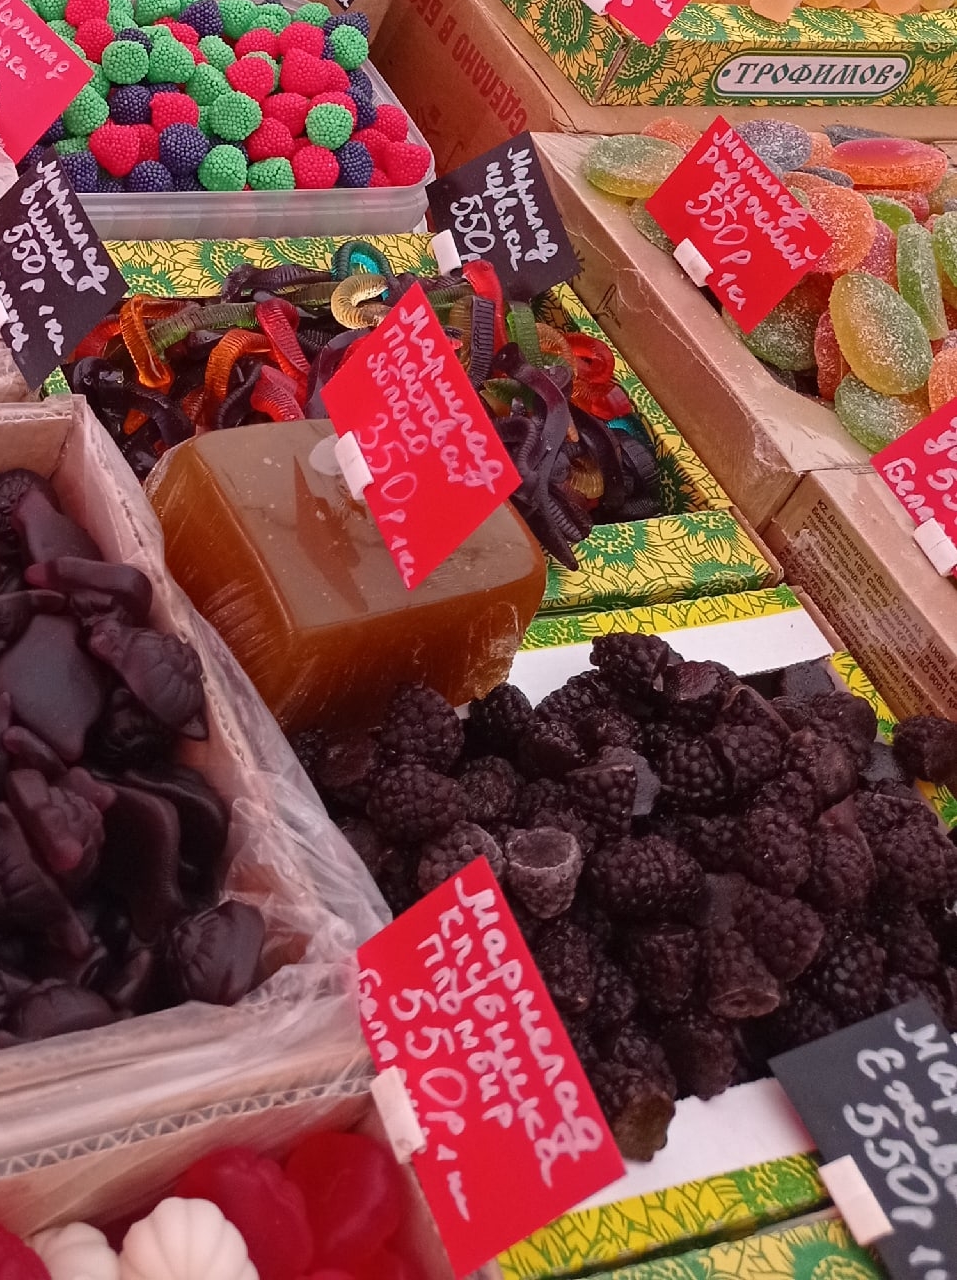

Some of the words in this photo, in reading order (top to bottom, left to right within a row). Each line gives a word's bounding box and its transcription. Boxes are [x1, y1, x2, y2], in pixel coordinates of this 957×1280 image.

[438, 15, 457, 45] В
[452, 33, 527, 137] СДЕЛАНО
[738, 62, 895, 86] ТРОФИМОВ
[37, 156, 109, 295] Мармелад
[483, 162, 520, 272] червяки
[508, 147, 559, 264] Мармелад
[685, 192, 751, 265] 550р
[712, 127, 808, 231] Мармелад
[3, 220, 45, 293] 550р
[399, 303, 503, 494] Мармелад
[355, 412, 418, 524] 350р
[390, 988, 468, 1136] 550р
[417, 933, 514, 1128] пломбир
[439, 905, 554, 1188] клубника
[456, 876, 603, 1161] Мармелад
[843, 1103, 939, 1229] 550р
